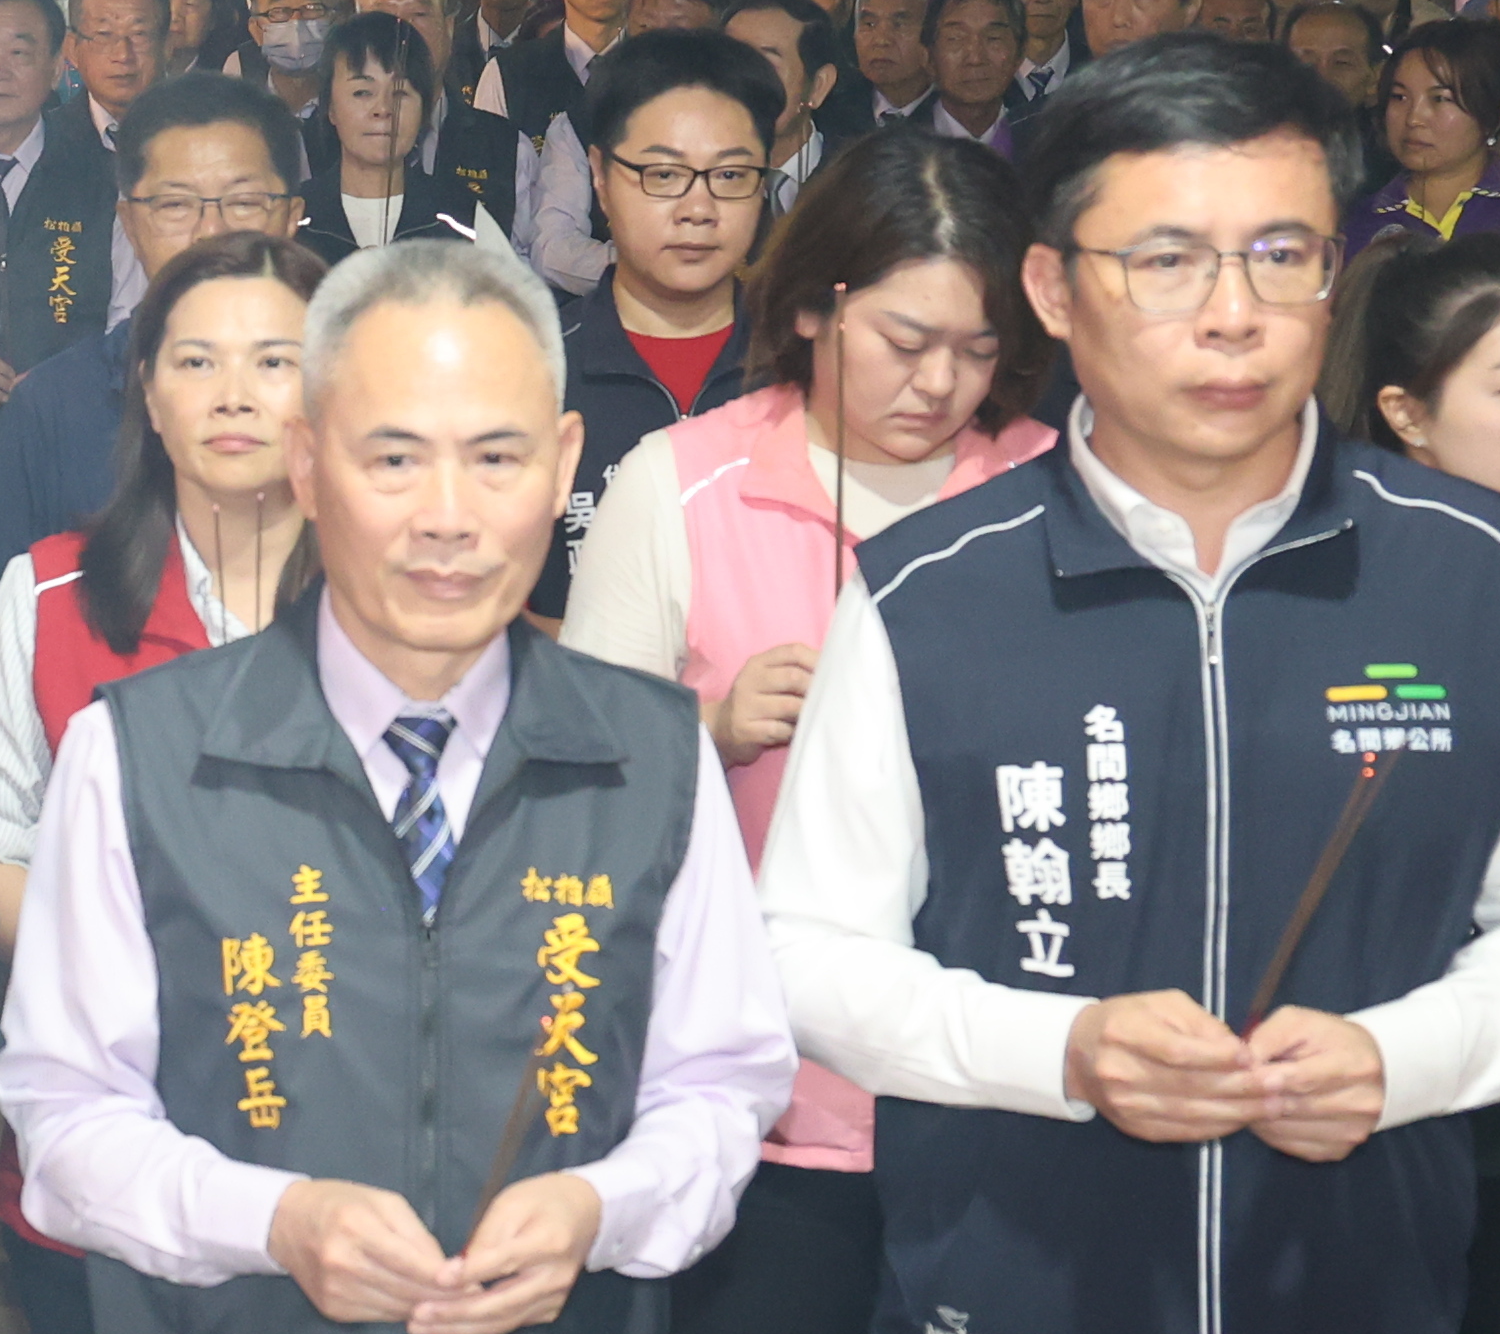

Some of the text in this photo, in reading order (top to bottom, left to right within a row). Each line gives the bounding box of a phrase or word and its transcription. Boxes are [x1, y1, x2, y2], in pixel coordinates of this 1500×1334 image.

[48, 236, 78, 324] 受天宮
[1083, 703, 1132, 901] 名間鄉鄉長
[1326, 701, 1451, 723] MINGJIAN
[288, 864, 335, 1038] 主任委員
[995, 759, 1077, 979] 陳翰立
[221, 931, 288, 1131] 陳登岳
[535, 912, 601, 1137] 受天宮
